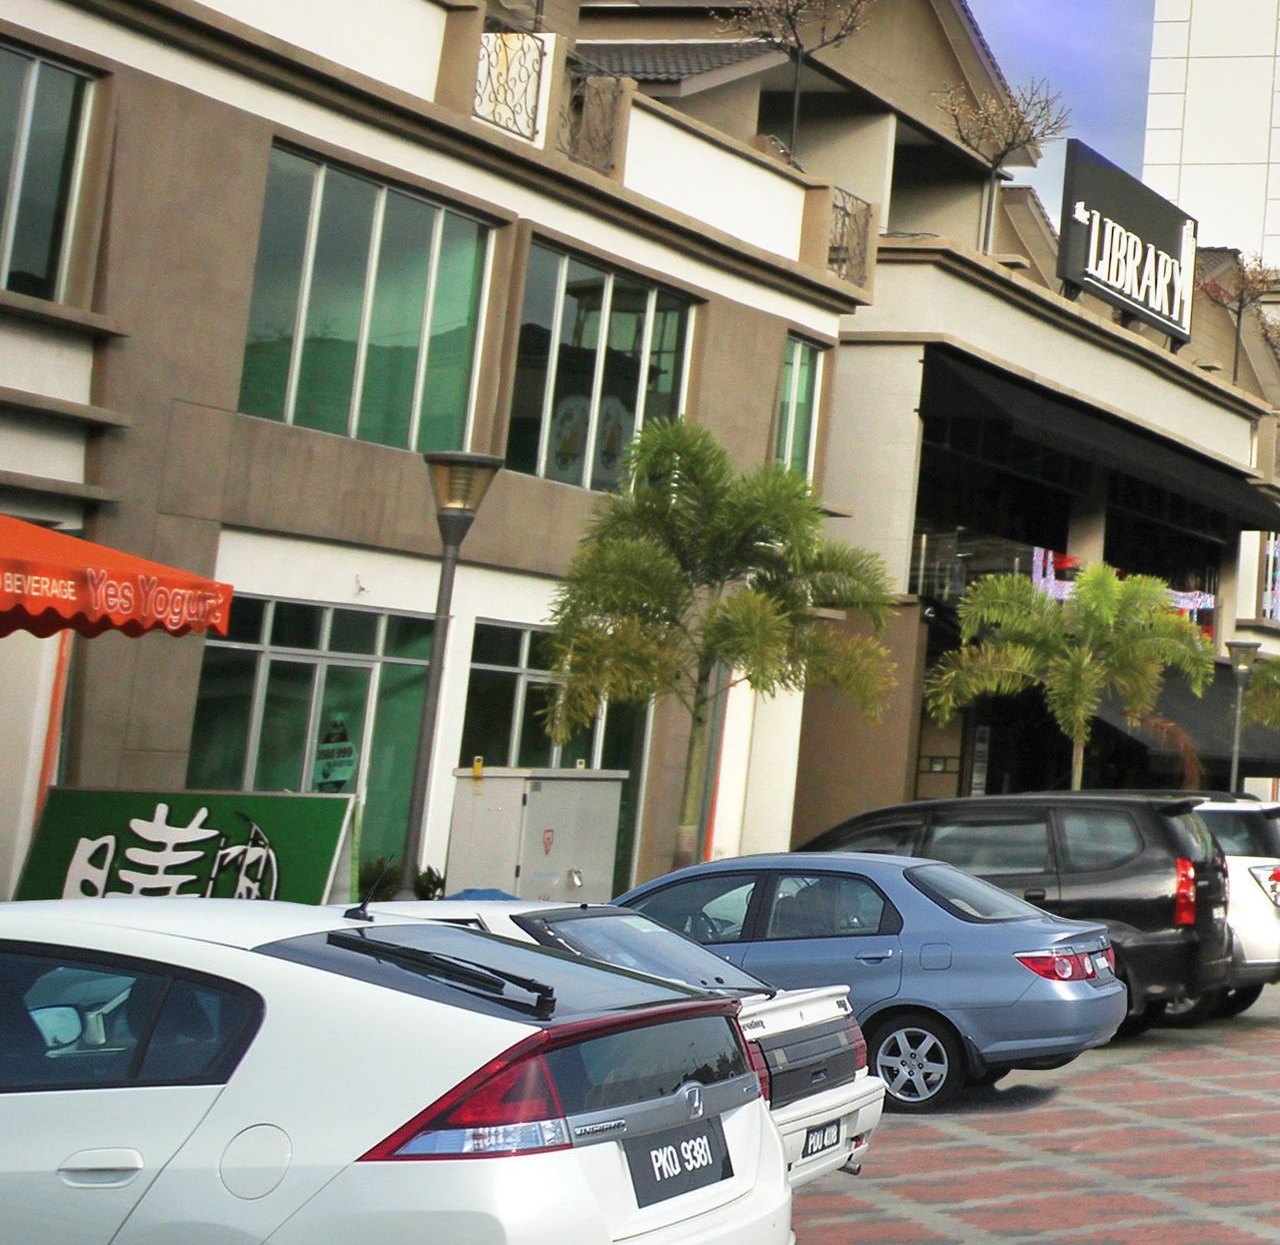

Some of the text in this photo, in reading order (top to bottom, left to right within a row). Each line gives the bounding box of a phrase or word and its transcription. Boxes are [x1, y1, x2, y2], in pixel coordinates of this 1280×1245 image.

[1085, 209, 1187, 322] LIBRARY
[3, 568, 225, 630] BEVERAGE Yes Yogurt
[681, 1135, 713, 1171] 9381
